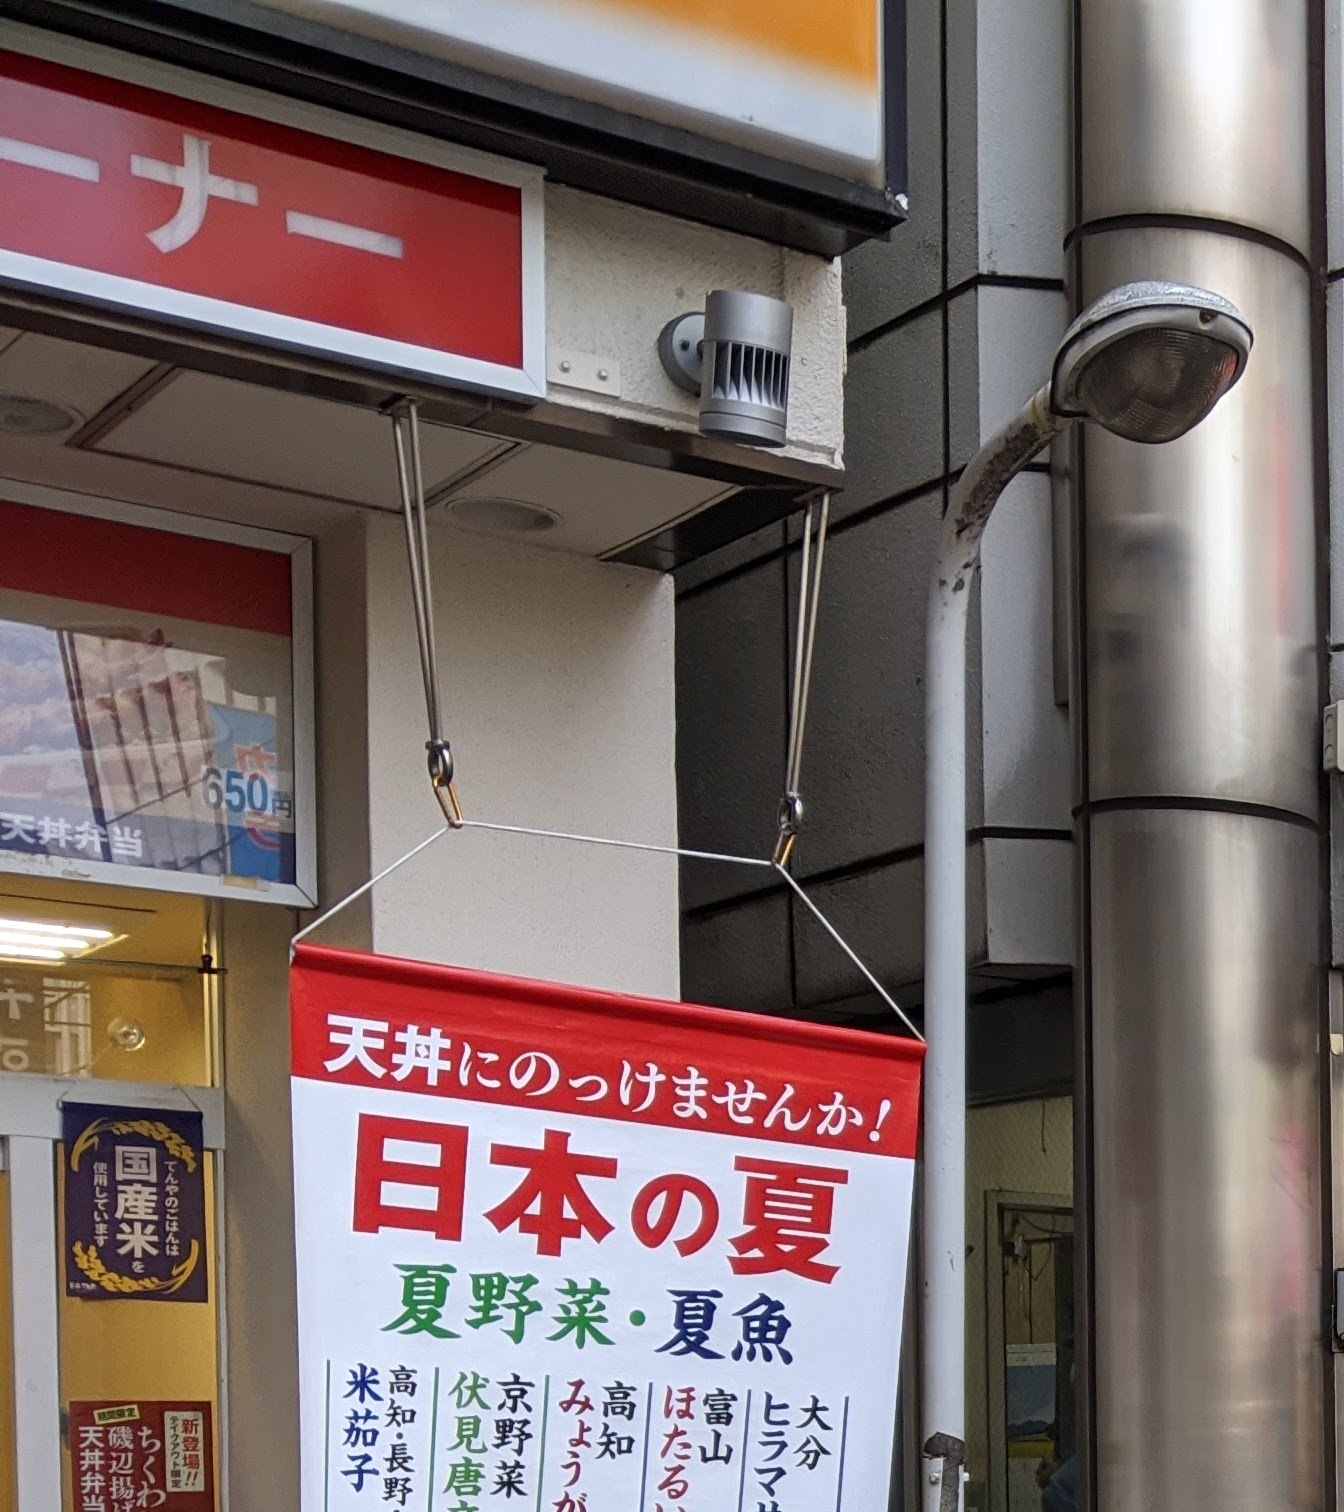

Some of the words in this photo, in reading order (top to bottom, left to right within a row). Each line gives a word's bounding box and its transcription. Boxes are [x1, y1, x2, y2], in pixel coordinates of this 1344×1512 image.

[352, 1113, 849, 1284] 日本の夏
[380, 1262, 794, 1366] 夏野菜・夏魚
[340, 1363, 384, 1492] 米茄子
[489, 1373, 536, 1498] 京野菜
[595, 1380, 638, 1459] 高知
[699, 1388, 740, 1465] 富山
[795, 1394, 832, 1470] 大分
[137, 1425, 166, 1508] ちくわ
